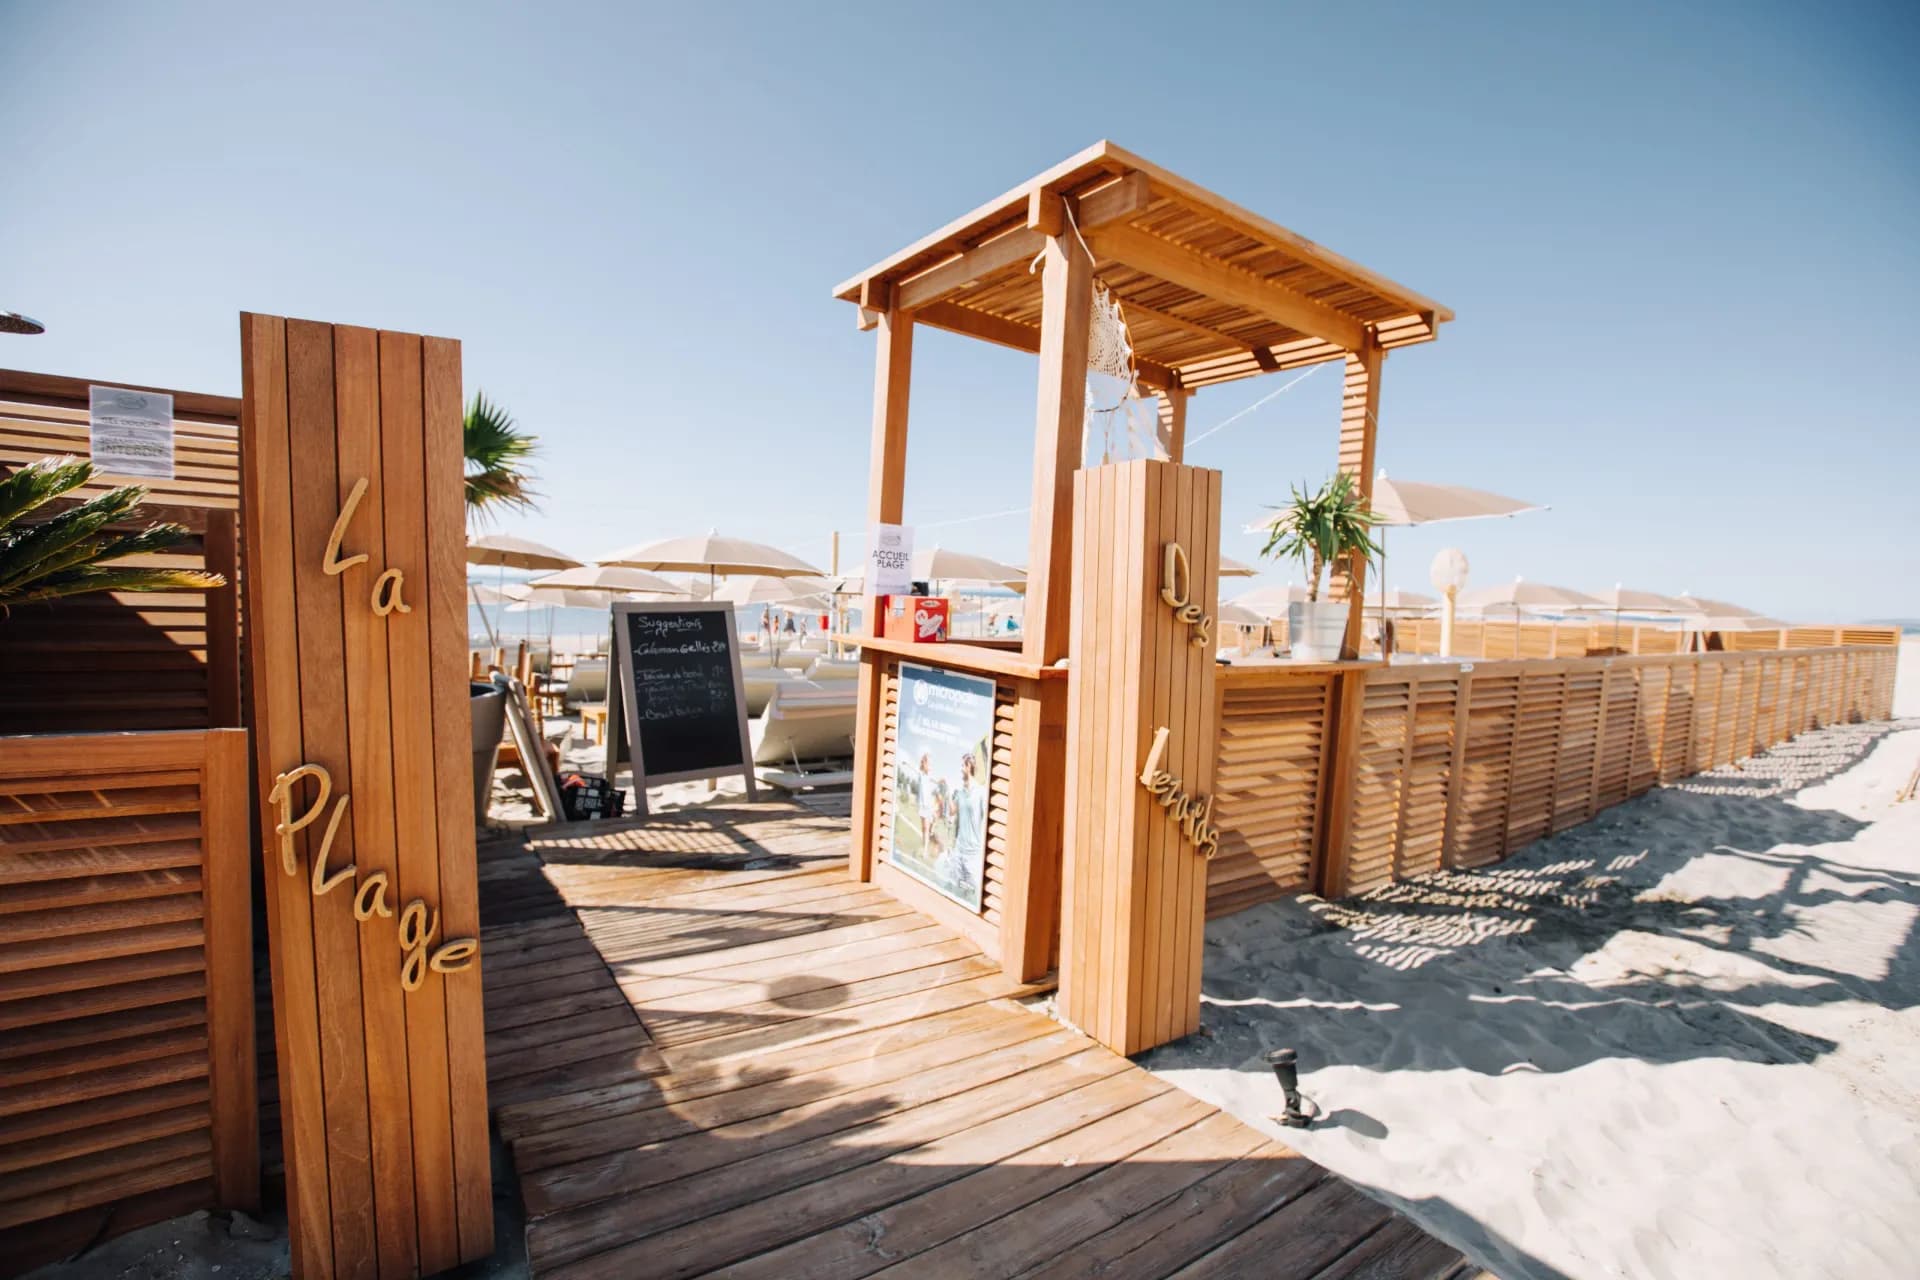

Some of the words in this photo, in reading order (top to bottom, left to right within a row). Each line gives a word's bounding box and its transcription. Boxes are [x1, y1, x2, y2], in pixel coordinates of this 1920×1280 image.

[323, 477, 412, 617] La
[872, 549, 910, 561] ACCUEIL
[876, 559, 905, 570] PLAGE
[1160, 542, 1213, 648] Des
[637, 616, 703, 637] Suggestions
